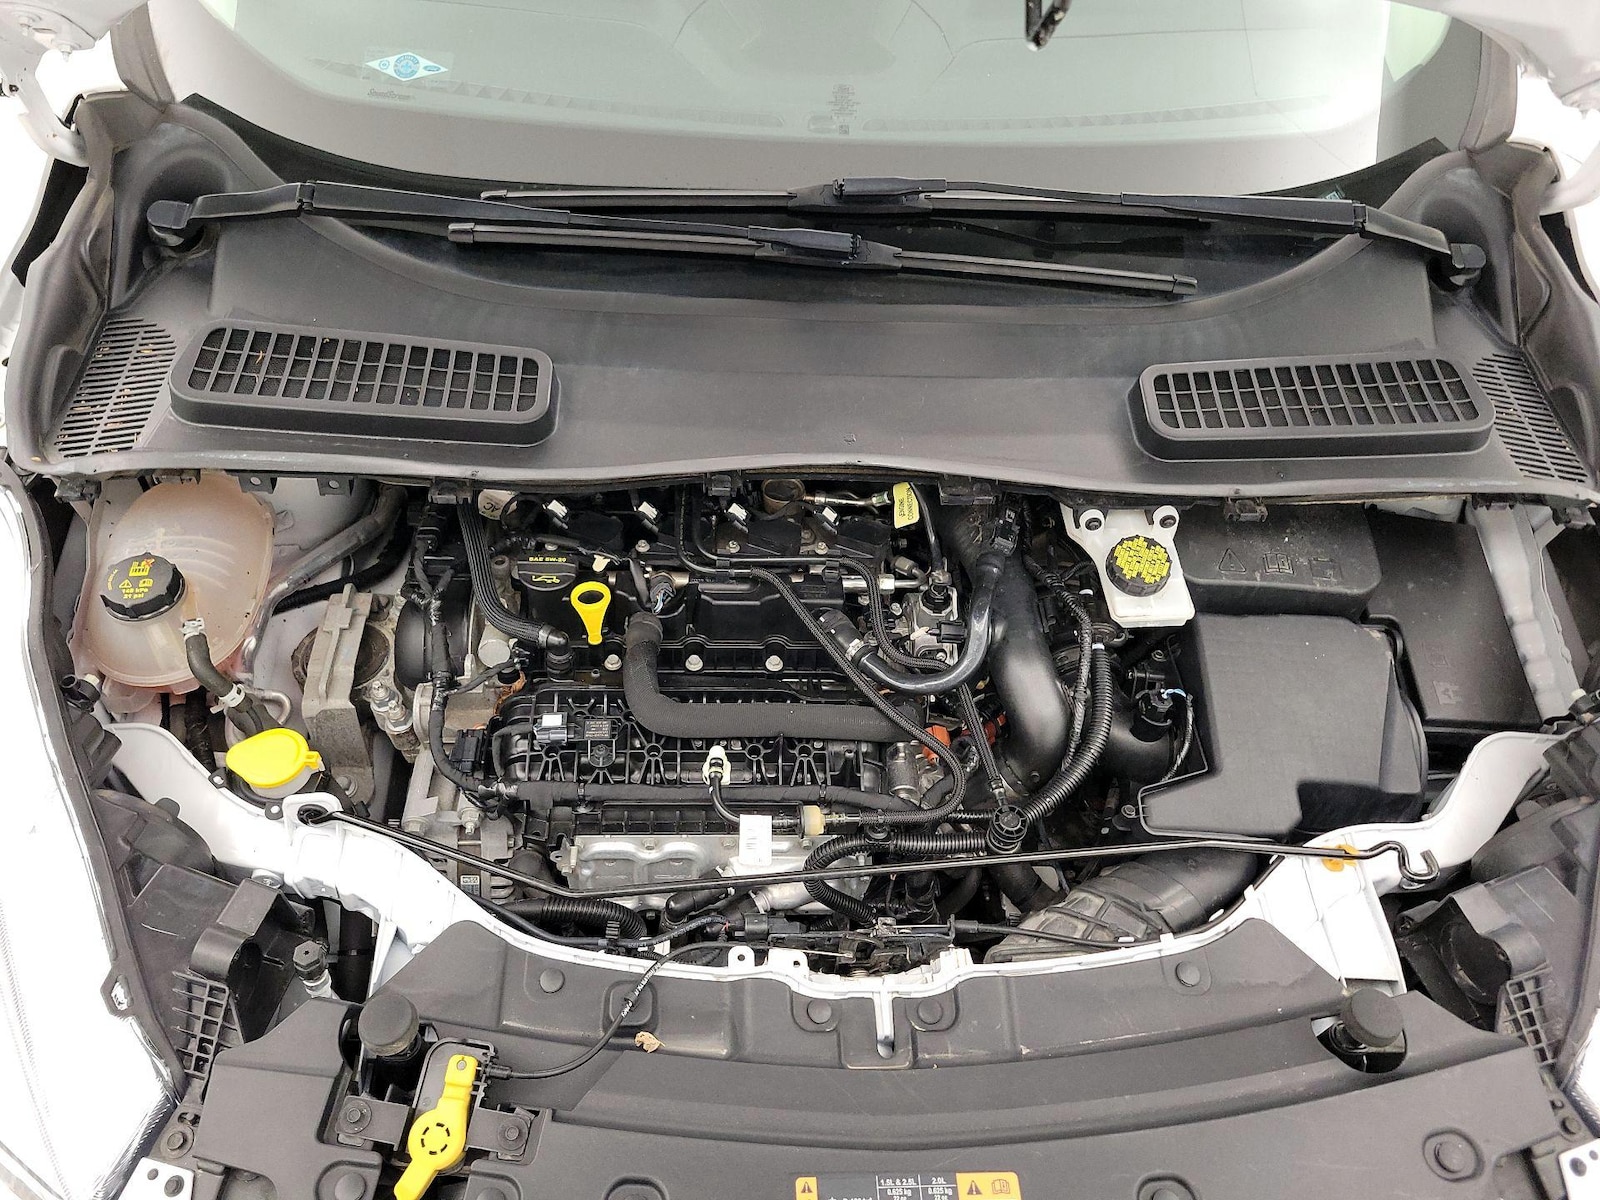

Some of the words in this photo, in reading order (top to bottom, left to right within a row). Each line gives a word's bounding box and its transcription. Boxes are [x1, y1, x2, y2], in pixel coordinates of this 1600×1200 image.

[895, 1178, 901, 1186] &
[887, 1188, 903, 1196] 0.625
[904, 1188, 912, 1197] kg
[928, 1187, 944, 1195] 0.625
[944, 1187, 953, 1196] kg
